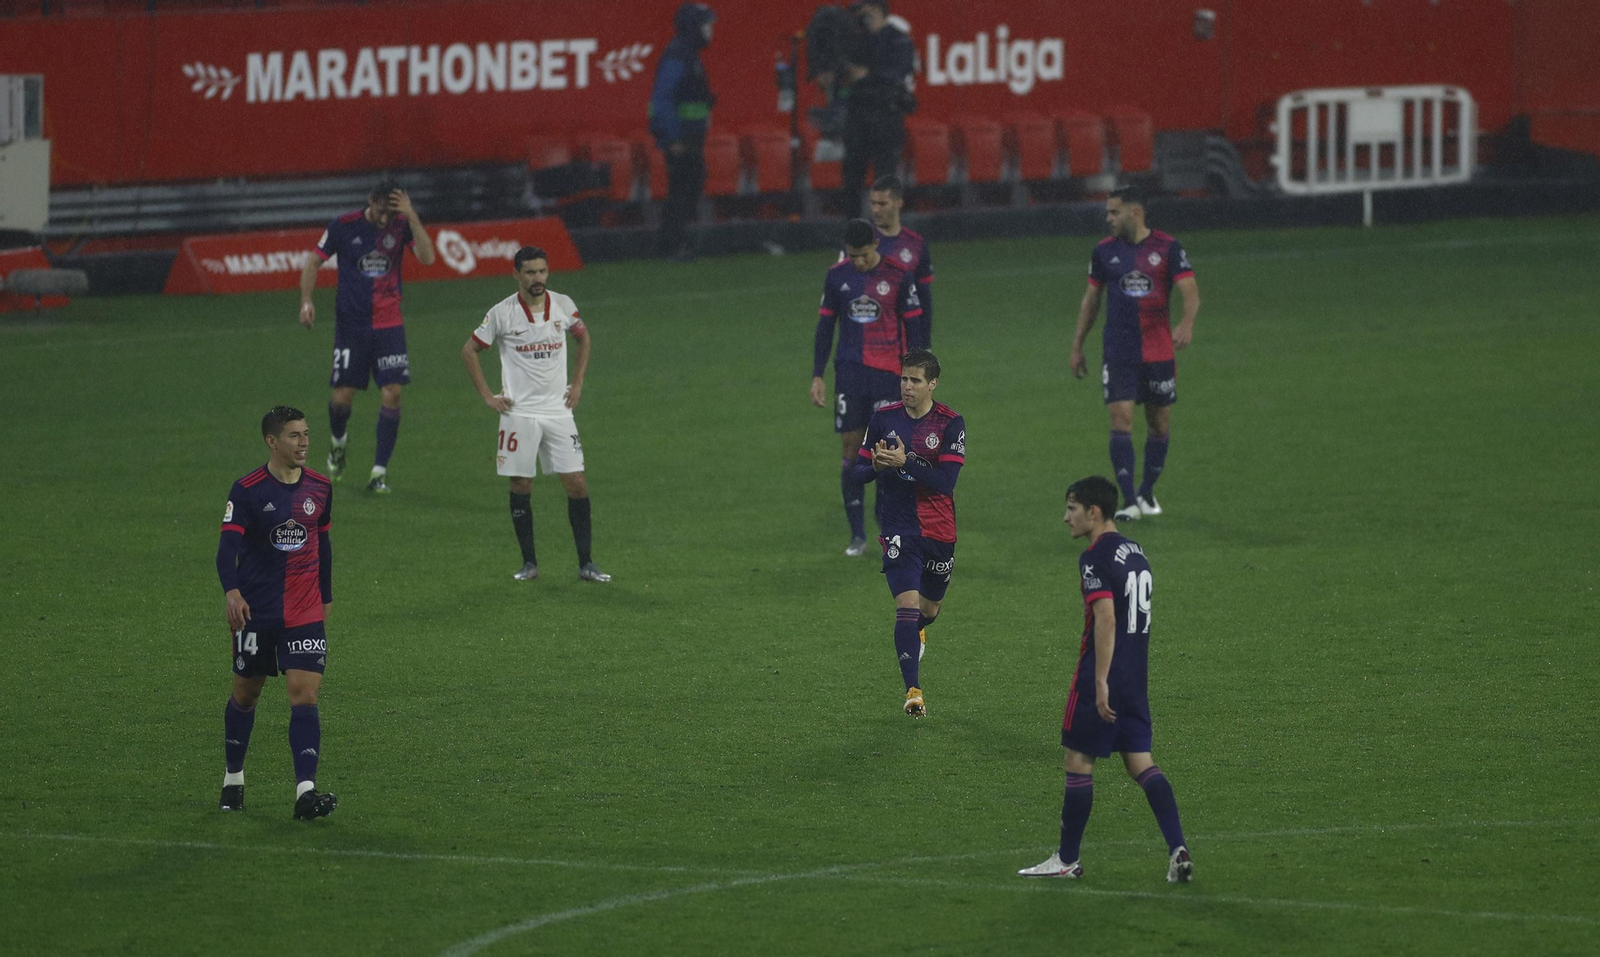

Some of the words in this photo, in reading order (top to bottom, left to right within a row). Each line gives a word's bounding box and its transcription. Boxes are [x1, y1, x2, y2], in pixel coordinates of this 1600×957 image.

[246, 38, 598, 103] MARATHONBET
[927, 24, 1064, 96] LaLiga
[333, 348, 350, 369] 21
[533, 351, 551, 359] BET
[499, 430, 518, 453] 16
[276, 528, 304, 536] Estrella
[276, 535, 302, 544] Galicia
[1124, 569, 1153, 634] 19
[235, 630, 259, 656] 14
